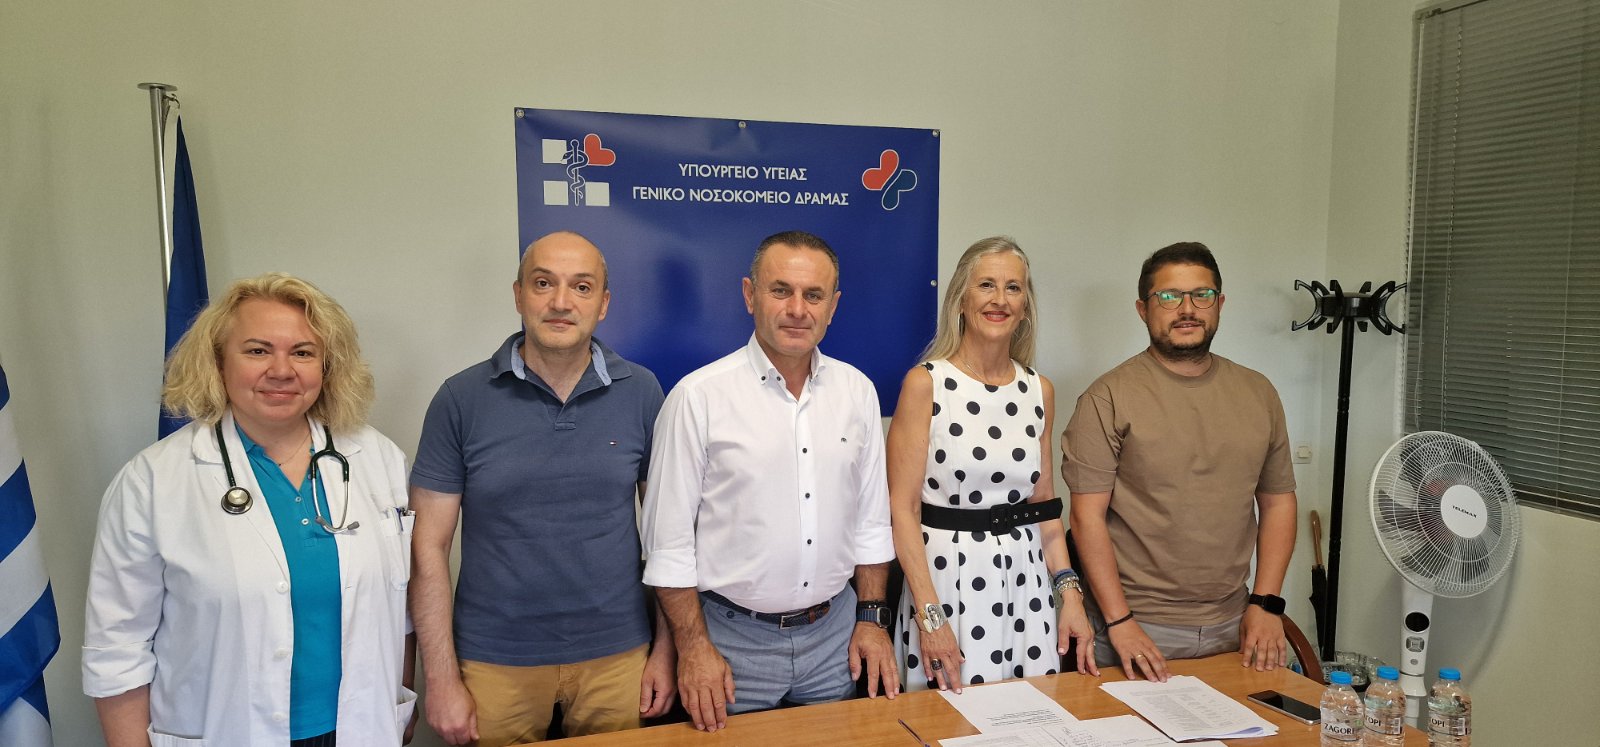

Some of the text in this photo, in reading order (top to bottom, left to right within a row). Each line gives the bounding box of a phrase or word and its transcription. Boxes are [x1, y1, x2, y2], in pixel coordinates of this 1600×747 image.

[678, 163, 808, 181] ΥΠΟΥΡΓΕΙΟ ΥΓΕΙΑΣ
[632, 186, 849, 206] ΓΕΝΙΚΟ ΝΟΣΟΚΟΜΕΙΟ ΔΡΑΜΑΣ
[1324, 722, 1356, 735] ZAGORI
